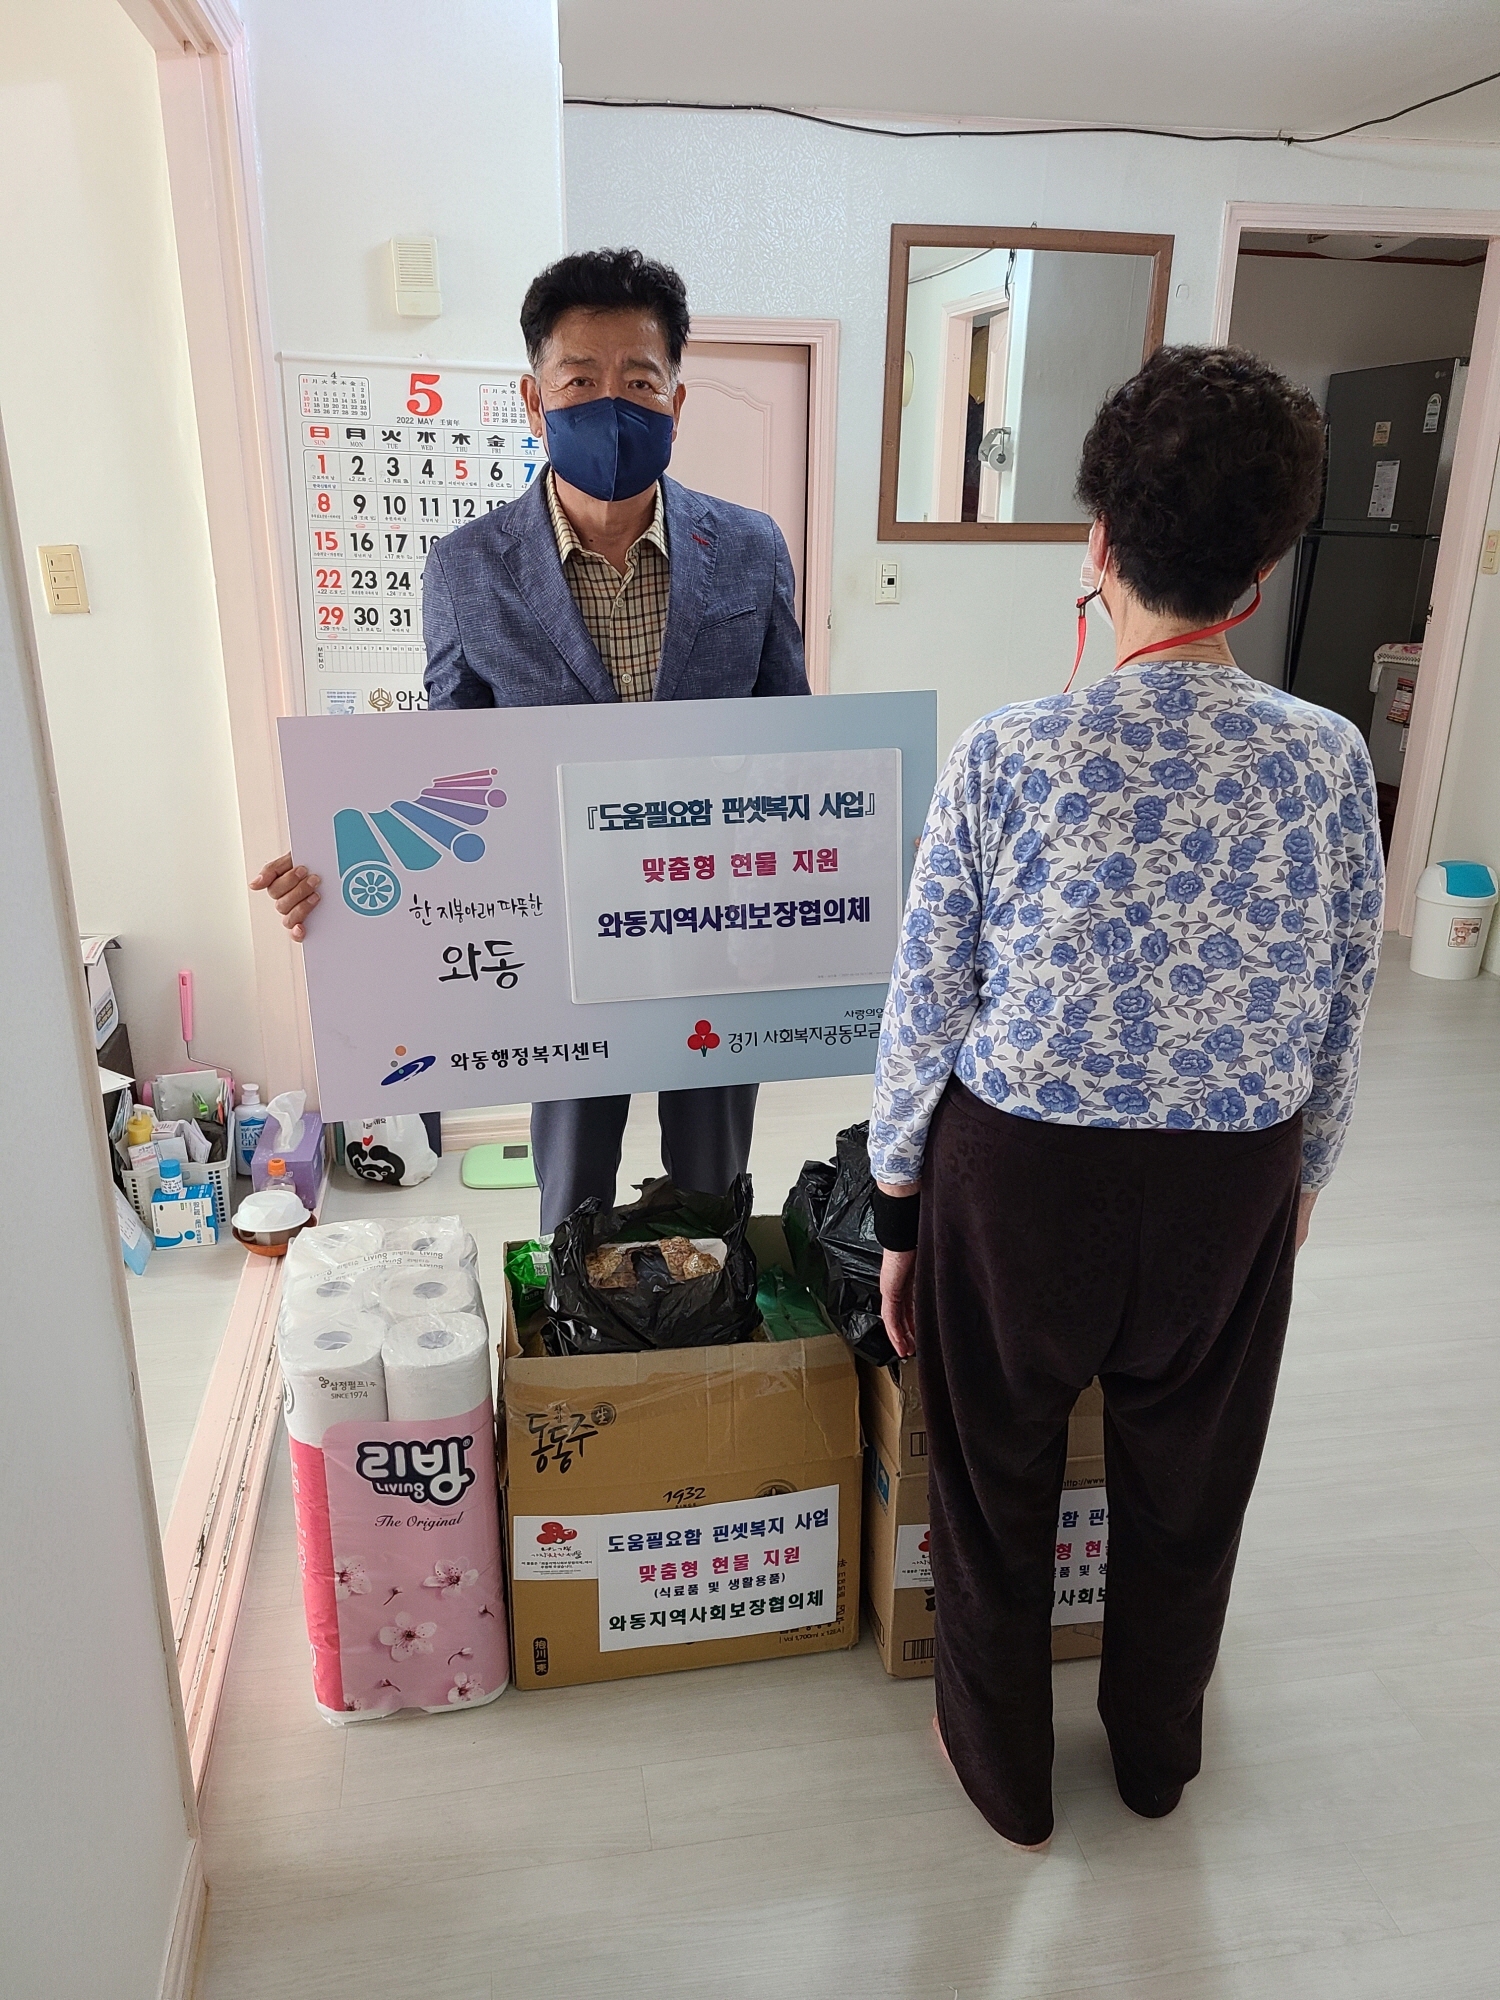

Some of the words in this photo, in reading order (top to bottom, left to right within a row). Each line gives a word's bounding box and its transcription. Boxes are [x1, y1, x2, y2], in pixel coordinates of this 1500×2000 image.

[330, 371, 337, 380] 4
[406, 373, 443, 417] 5
[309, 426, 330, 439] 日
[346, 428, 366, 441] 月
[381, 430, 402, 443] 火
[416, 431, 437, 444] 水
[451, 433, 471, 445] 木
[486, 434, 506, 448] 金
[520, 437, 540, 449] 土
[318, 455, 325, 474] 1
[351, 455, 365, 475] 2
[386, 456, 400, 477] 3
[421, 458, 434, 479] 4
[455, 459, 468, 480] 5
[490, 461, 503, 481] 6
[523, 463, 537, 483] 7
[317, 492, 331, 513] 8
[353, 494, 367, 514] 9
[383, 495, 407, 515] 10
[419, 497, 440, 517] 11
[452, 498, 476, 518] 12
[314, 531, 339, 551] 15
[350, 532, 374, 552] 16
[384, 533, 409, 553] 17
[316, 568, 342, 589] 22
[351, 569, 378, 589] 23
[386, 571, 411, 591] 24
[318, 606, 344, 625] 29
[353, 606, 379, 626] 30
[389, 608, 411, 627] 31
[642, 854, 716, 884] 맞춤형
[730, 851, 778, 878] 현물
[792, 847, 839, 874] 지원
[409, 893, 432, 926] 한
[436, 895, 496, 924] 지붕아래
[497, 892, 544, 919] 따뜻한
[597, 896, 871, 939] 와동지역사회보장협의체
[437, 938, 526, 990] 와동
[727, 1029, 759, 1054] 경기
[763, 1021, 881, 1046] 사회복지공동모금
[450, 1040, 610, 1071] 와동행정복지센터
[241, 1130, 263, 1140] HAN
[525, 1413, 599, 1474] 동동주
[662, 1486, 706, 1504] 1932
[374, 1515, 402, 1527] The
[406, 1511, 465, 1532] Original
[607, 1527, 703, 1554] 도움필요함
[712, 1516, 785, 1544] 핀셋복지
[794, 1508, 830, 1530] 사업
[638, 1559, 700, 1585] 맞춤형
[711, 1552, 751, 1575] 현물
[762, 1546, 800, 1568] 지원
[1079, 1565, 1090, 1576] 및
[653, 1580, 700, 1599] (식료품
[708, 1578, 720, 1594] 및
[728, 1572, 787, 1591] 생활용품)
[609, 1588, 824, 1632] 와동지역사회보장협의체
